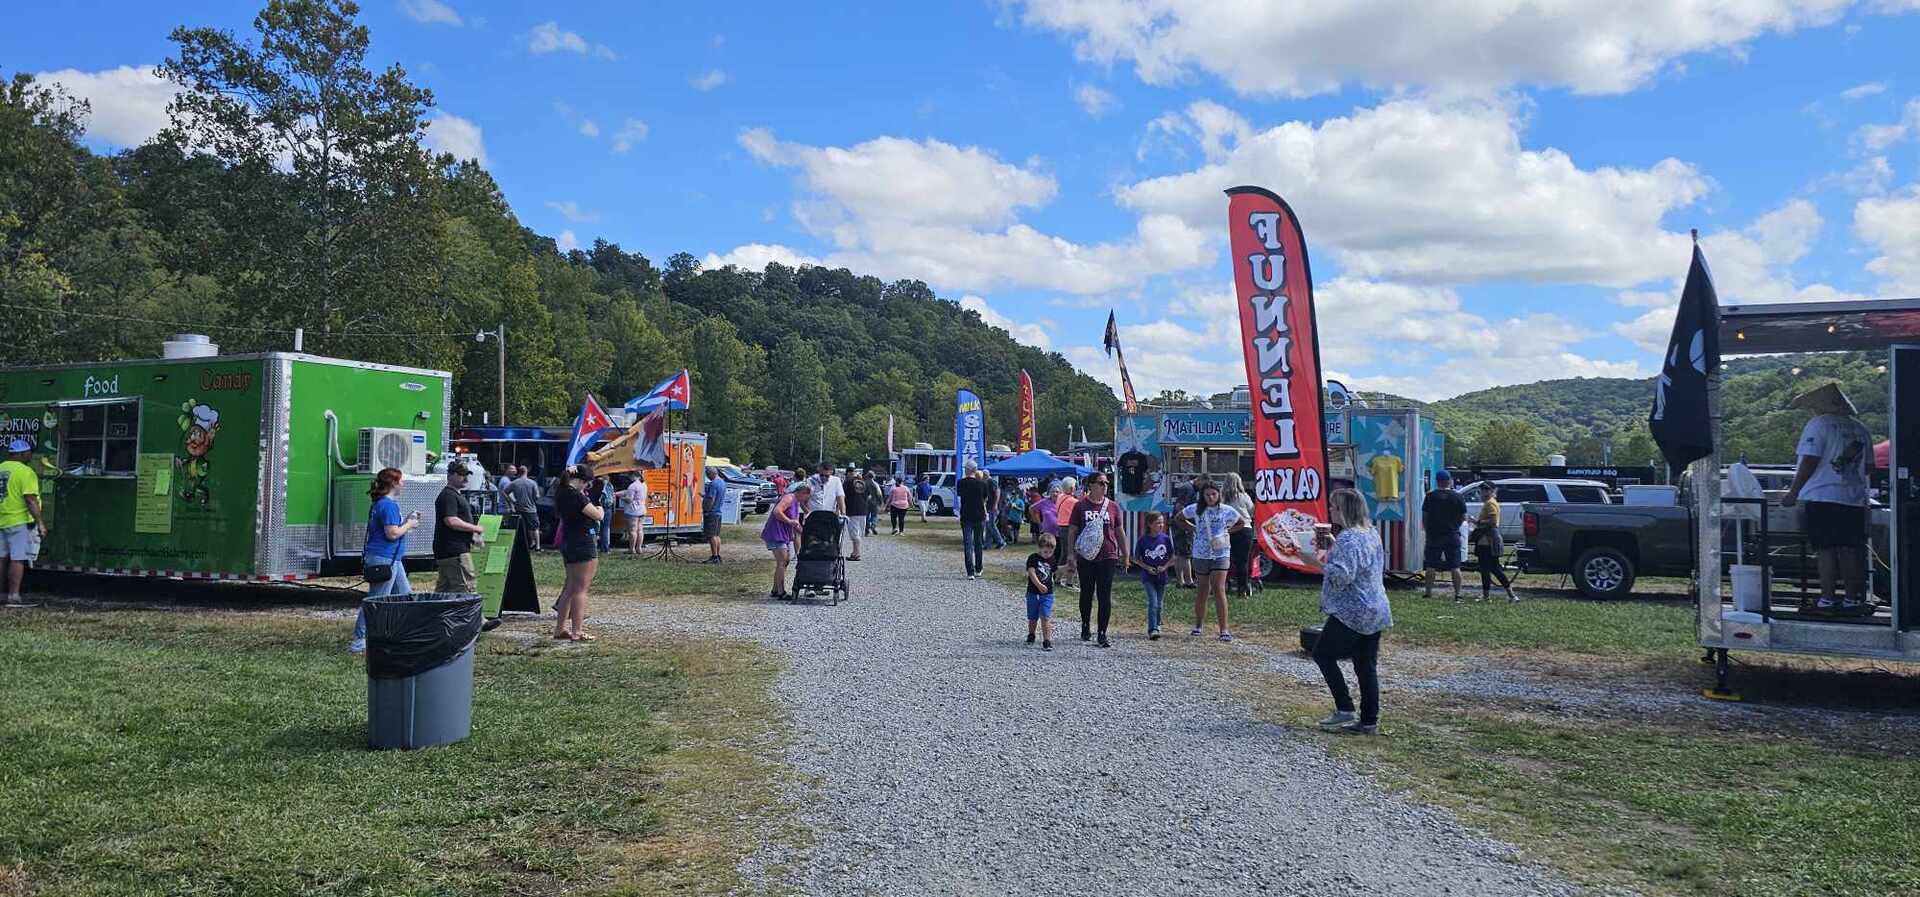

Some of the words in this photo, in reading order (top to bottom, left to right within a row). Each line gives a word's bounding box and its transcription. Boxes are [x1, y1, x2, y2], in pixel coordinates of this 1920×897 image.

[84, 375, 119, 398] food
[199, 369, 252, 392] Candy
[1164, 419, 1236, 435] MATILDA'S
[962, 413, 980, 478] SHAK
